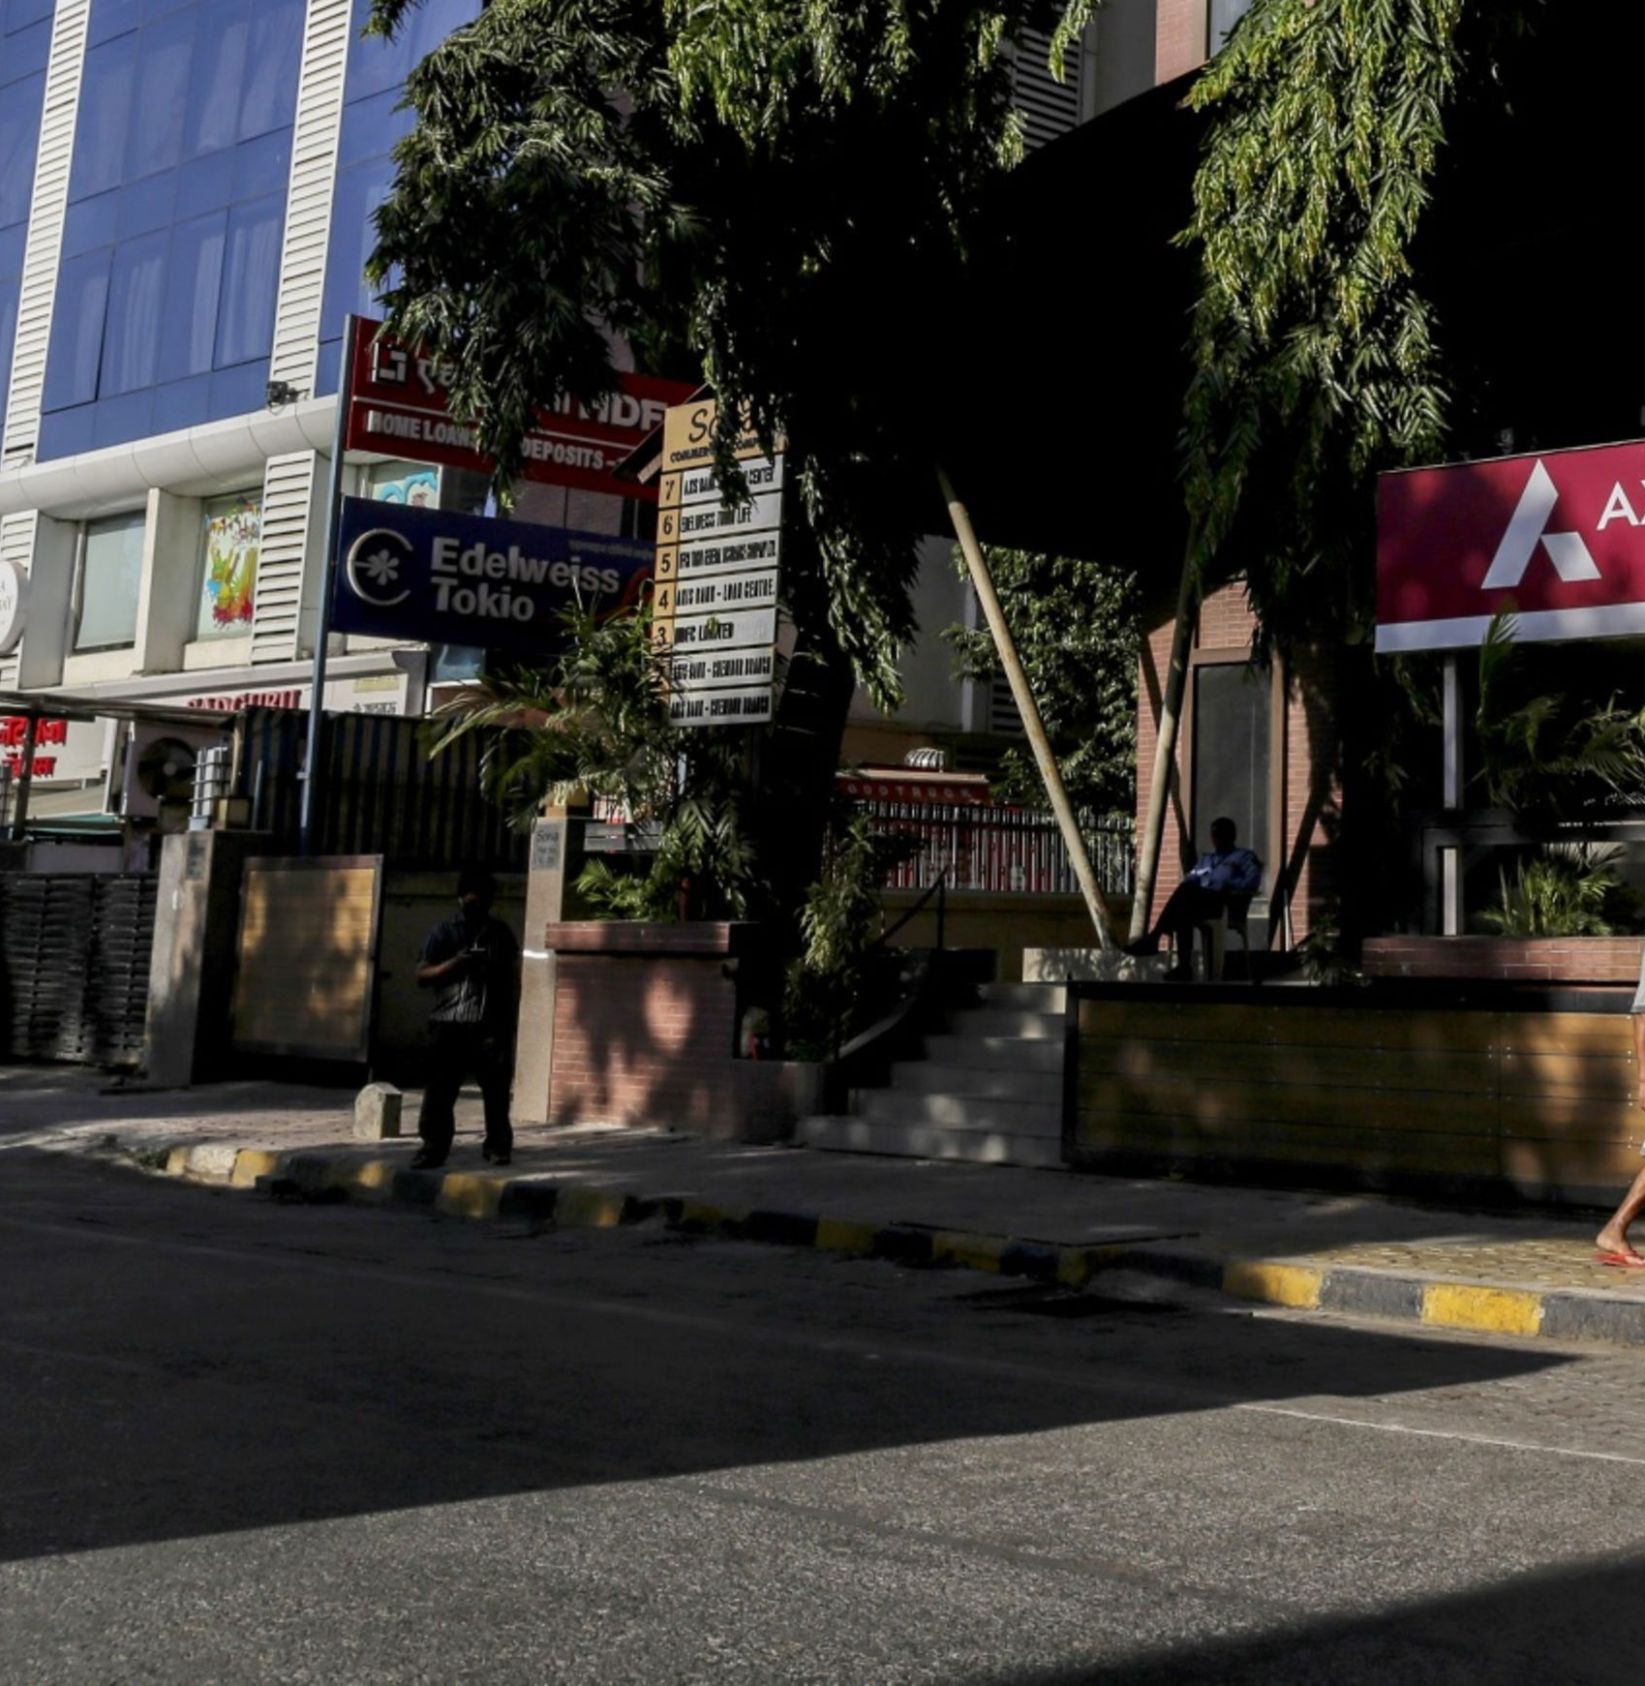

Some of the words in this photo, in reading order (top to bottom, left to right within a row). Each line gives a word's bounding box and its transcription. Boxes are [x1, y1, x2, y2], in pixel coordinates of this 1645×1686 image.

[577, 388, 668, 432] HDF
[366, 409, 421, 440] HOME
[520, 436, 605, 471] DEPOSITS
[663, 514, 673, 536] 6
[431, 536, 620, 595] Edelweiss
[661, 553, 671, 574] 5
[430, 576, 535, 622] Tokio
[658, 590, 669, 610] 4
